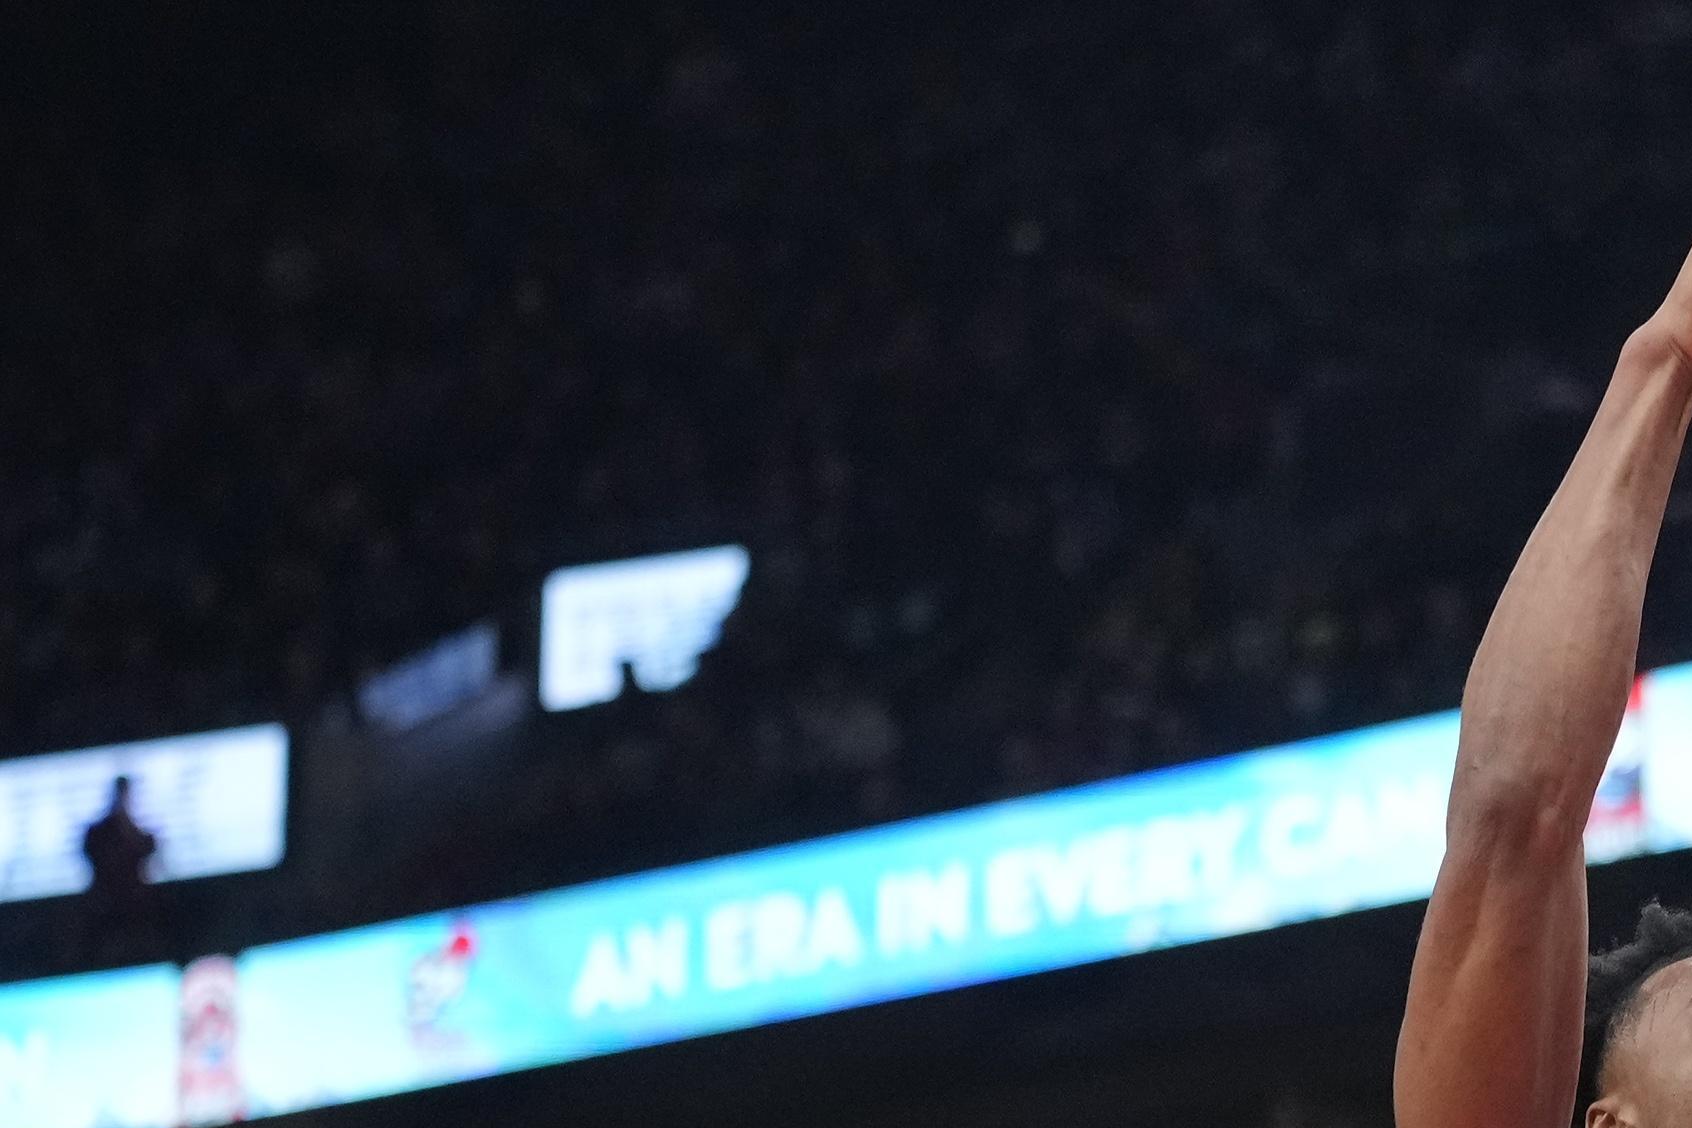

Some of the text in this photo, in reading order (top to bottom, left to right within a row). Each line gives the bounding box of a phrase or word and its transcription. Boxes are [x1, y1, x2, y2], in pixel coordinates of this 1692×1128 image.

[571, 915, 687, 1017] AN
[702, 885, 866, 993] ERA
[873, 856, 970, 960] IN
[987, 804, 1249, 936] EVERY
